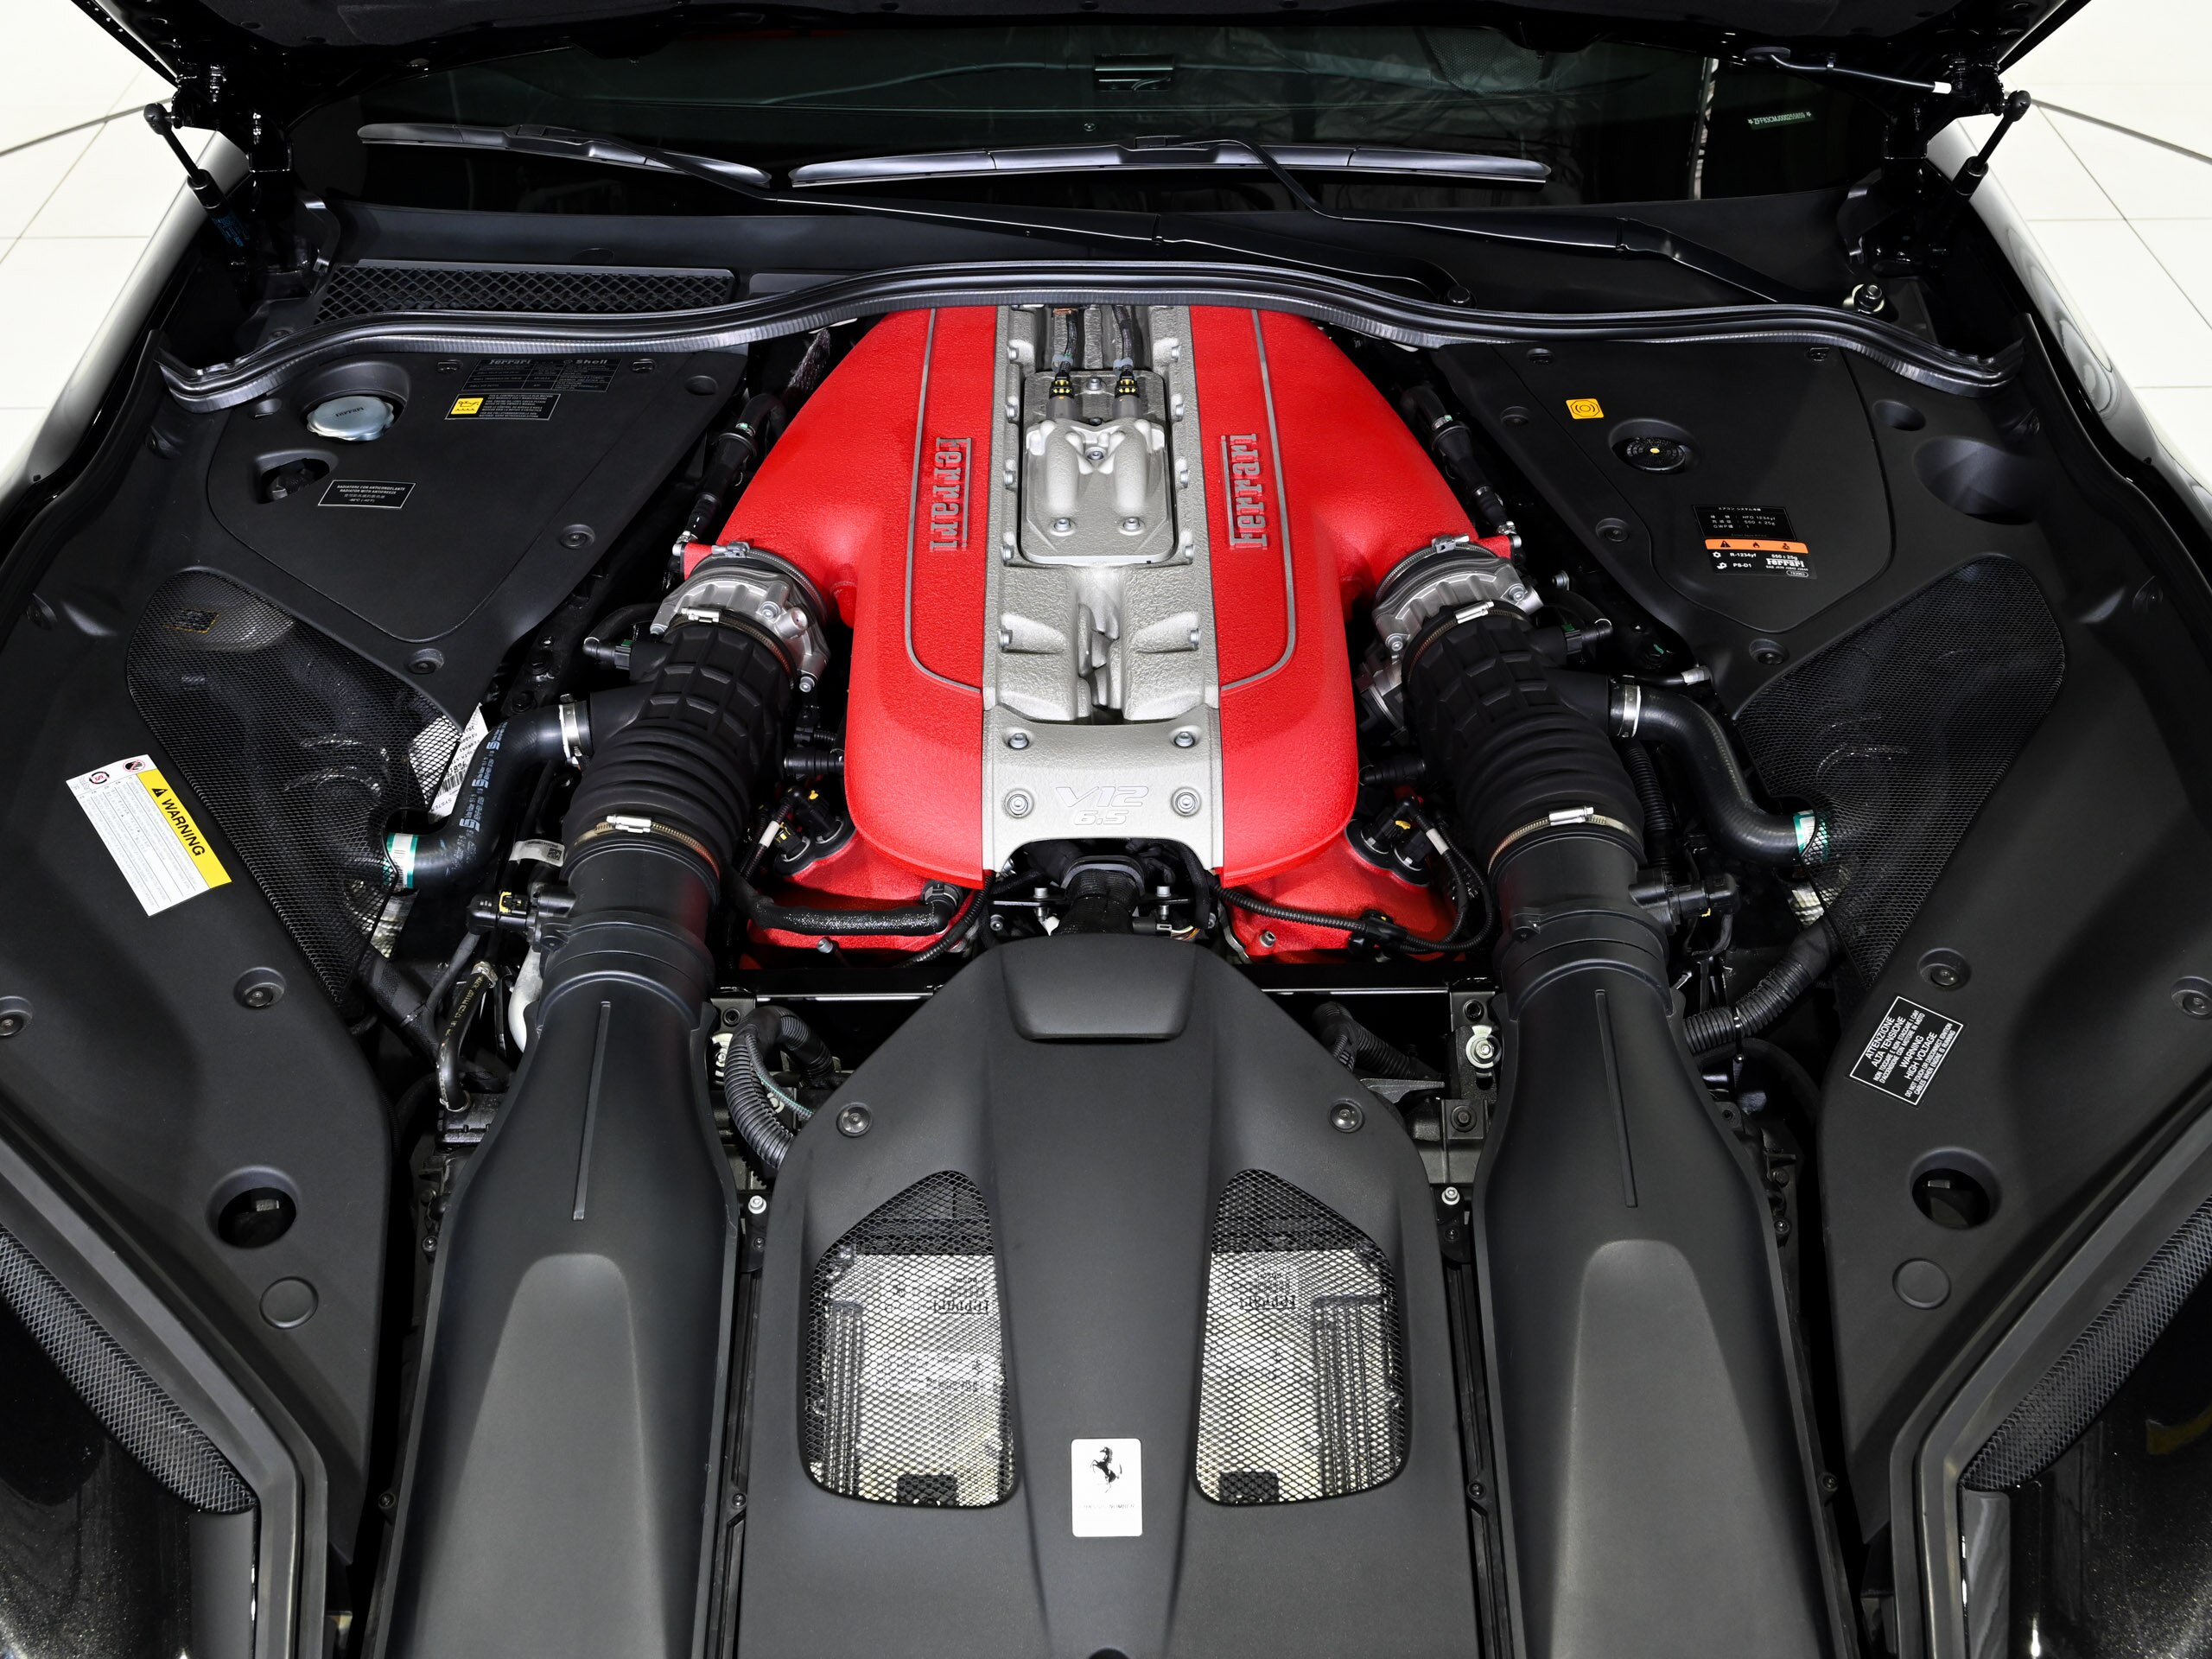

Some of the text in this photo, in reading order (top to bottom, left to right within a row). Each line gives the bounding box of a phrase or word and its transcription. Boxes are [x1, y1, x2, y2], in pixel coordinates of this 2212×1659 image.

[929, 436, 972, 552] Ferrari
[1219, 433, 1268, 550] Ferrari
[1766, 558, 1805, 567] Ferrari
[1055, 785, 1149, 807] V12
[1074, 810, 1129, 825] 6.5
[162, 798, 206, 856] WARNING
[1865, 1016, 1895, 1059] ATTENZIONE
[1871, 1016, 1906, 1067] ALTA TENSIONE
[1872, 1071, 1883, 1081] NON
[1878, 1053, 1893, 1071] TOCCARE
[1891, 1040, 1901, 1051] NON
[1897, 1021, 1913, 1041] STACCARE
[1899, 1035, 1924, 1068] WARNING
[1901, 1029, 1915, 1046] MOTORE
[1914, 1013, 1925, 1026] MOTO
[1904, 1032, 1937, 1079] HIGH VOLTAGE
[1914, 1079, 1927, 1095] CABLES
[1923, 1066, 1934, 1079] WHEN
[1929, 1052, 1942, 1067] ENGINE
[1942, 1030, 1955, 1048] RUNNING
[1908, 1081, 1917, 1090] NOT
[1913, 1068, 1925, 1082] TOUCH
